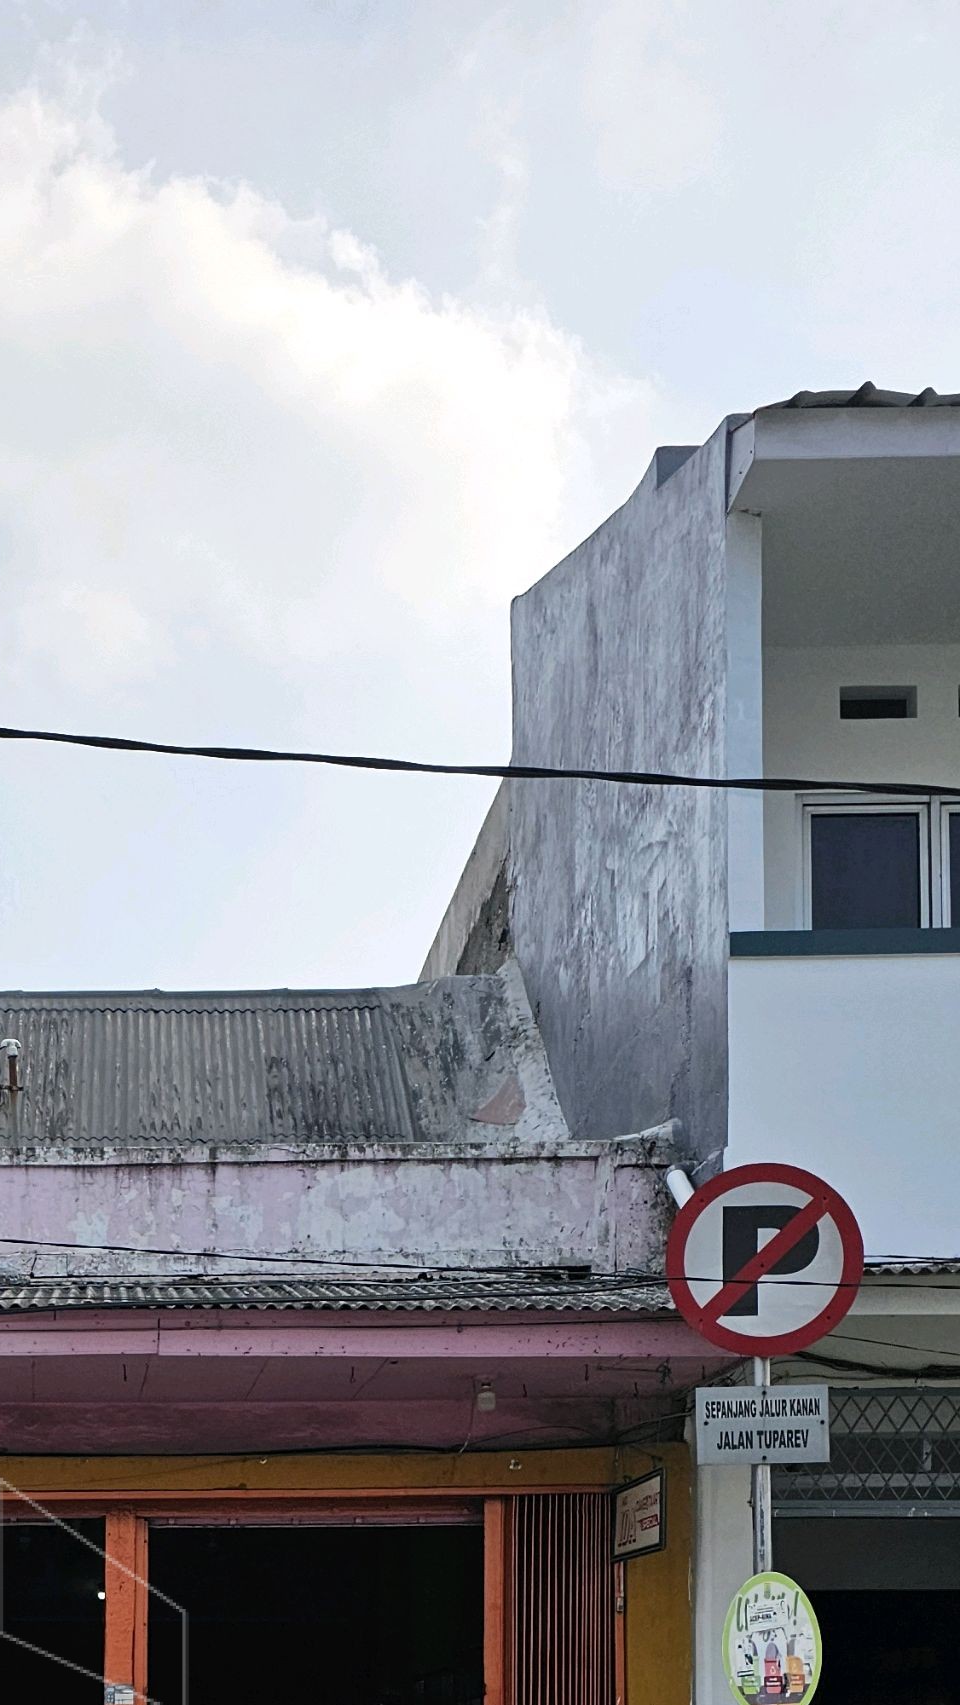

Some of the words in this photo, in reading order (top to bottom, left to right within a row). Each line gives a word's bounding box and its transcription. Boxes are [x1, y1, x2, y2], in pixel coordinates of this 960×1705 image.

[722, 1206, 820, 1316] P
[705, 1400, 757, 1419] SEPANJANG
[759, 1399, 787, 1417] JALUR
[789, 1398, 820, 1415] KANAN
[717, 1431, 754, 1450] JALAN
[757, 1429, 808, 1449] TUPAREV
